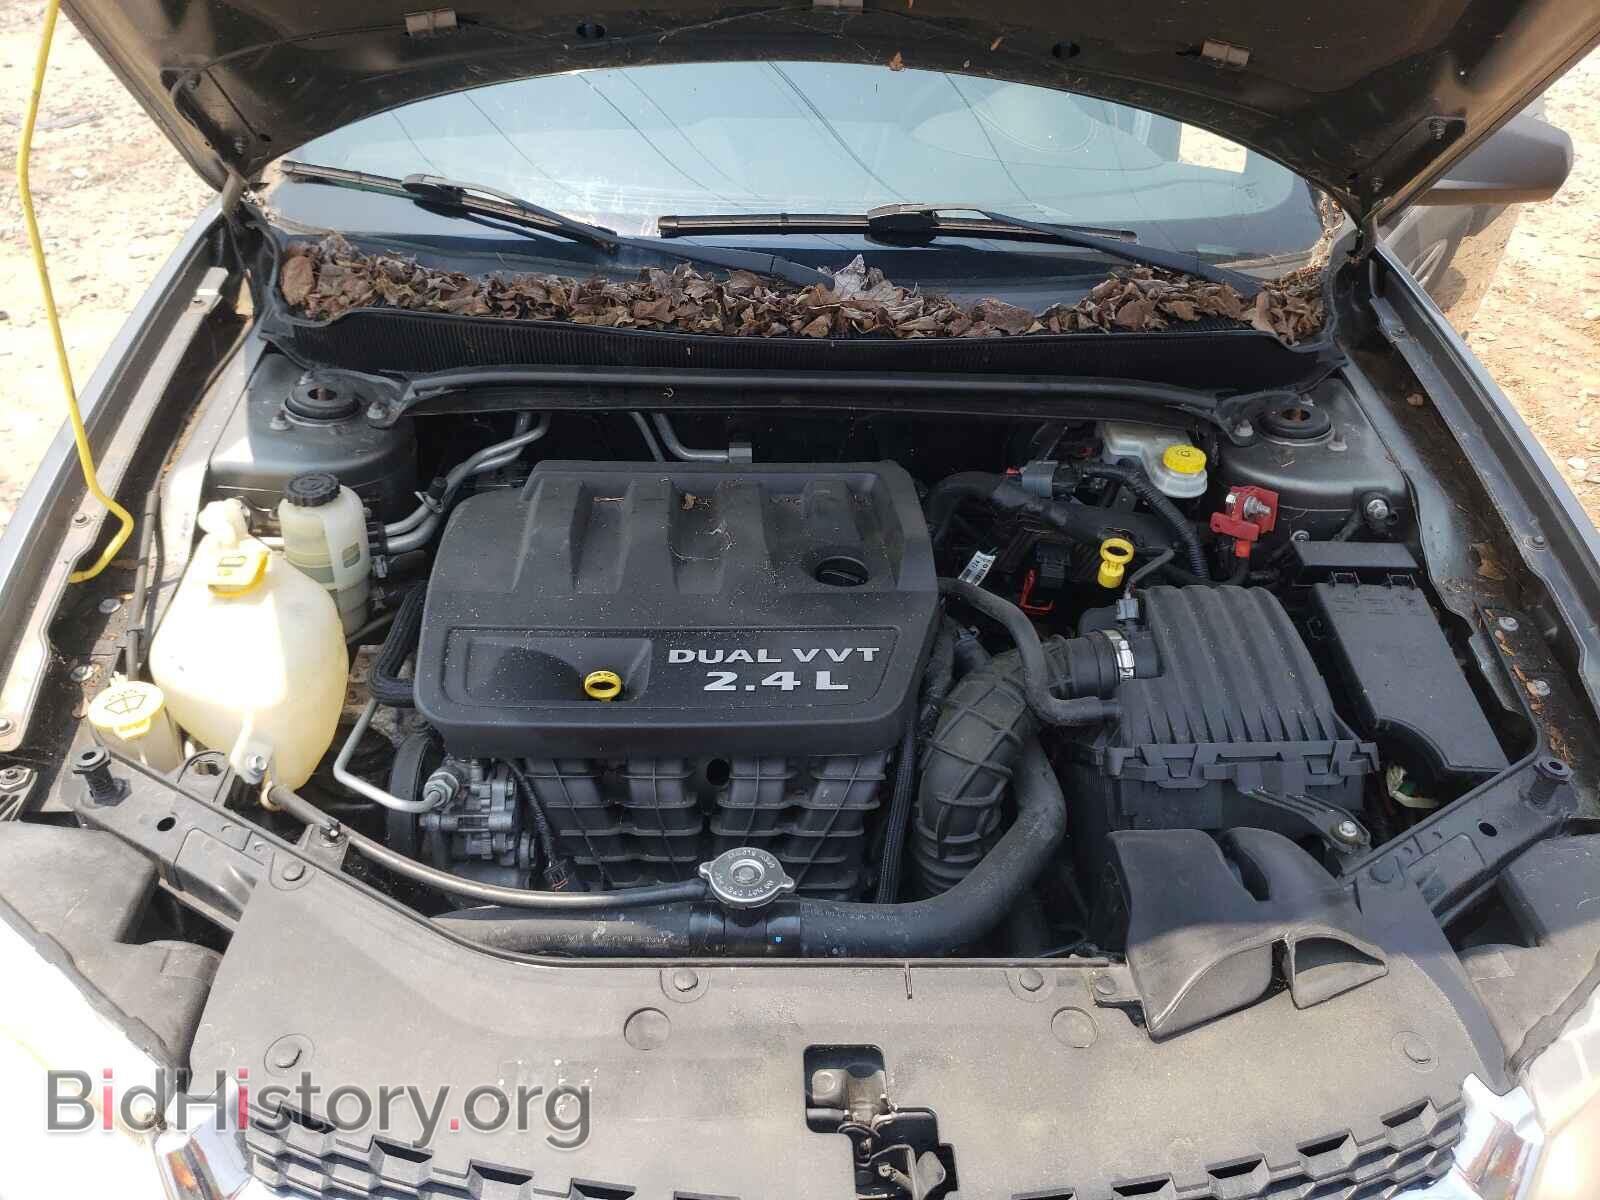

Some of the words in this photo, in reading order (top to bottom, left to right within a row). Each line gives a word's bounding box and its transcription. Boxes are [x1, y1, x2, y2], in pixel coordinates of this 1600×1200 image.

[668, 648, 782, 664] DUAL
[791, 647, 880, 663] VVT
[703, 671, 801, 691] 2.4
